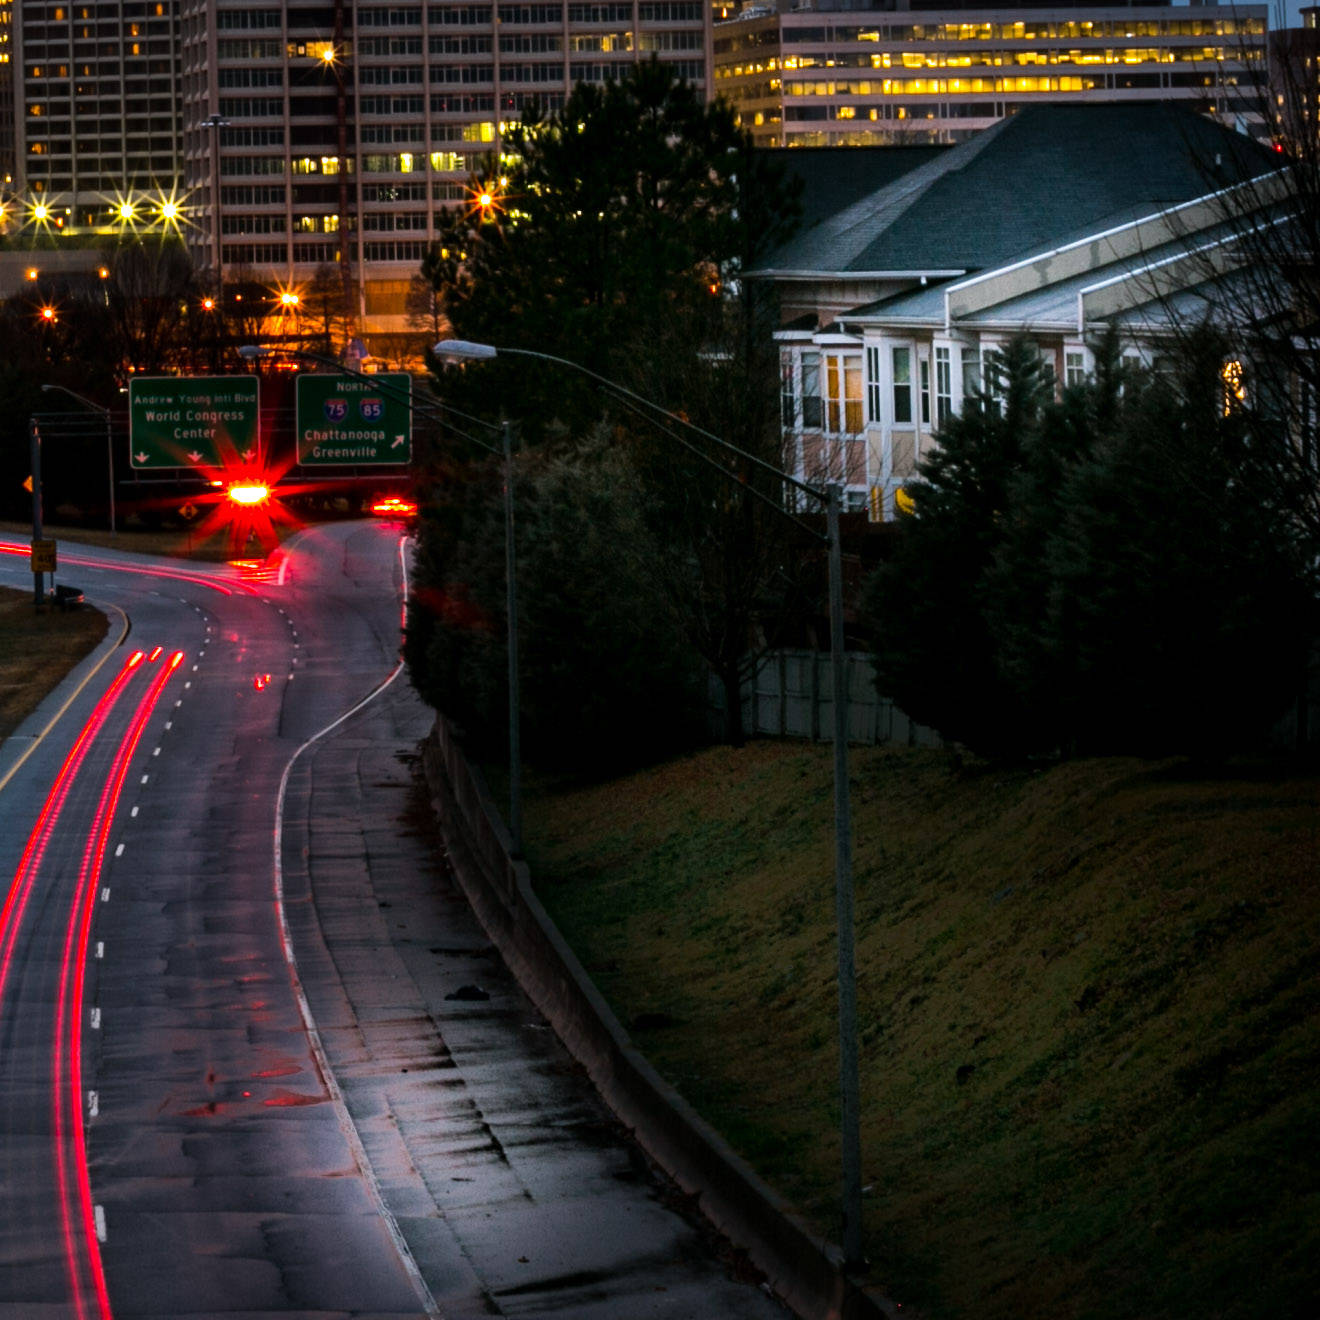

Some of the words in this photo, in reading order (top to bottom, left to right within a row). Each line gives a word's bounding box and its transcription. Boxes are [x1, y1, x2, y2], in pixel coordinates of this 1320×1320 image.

[134, 395, 173, 404] Andrew
[179, 394, 212, 406] Young
[234, 393, 256, 403] Blvd
[145, 410, 180, 422] World
[185, 410, 245, 423] Congress
[327, 404, 345, 416] 75
[362, 404, 381, 417] 85
[173, 427, 216, 439] Center
[304, 430, 385, 443] Chattanooga
[312, 446, 377, 458] Greenville
